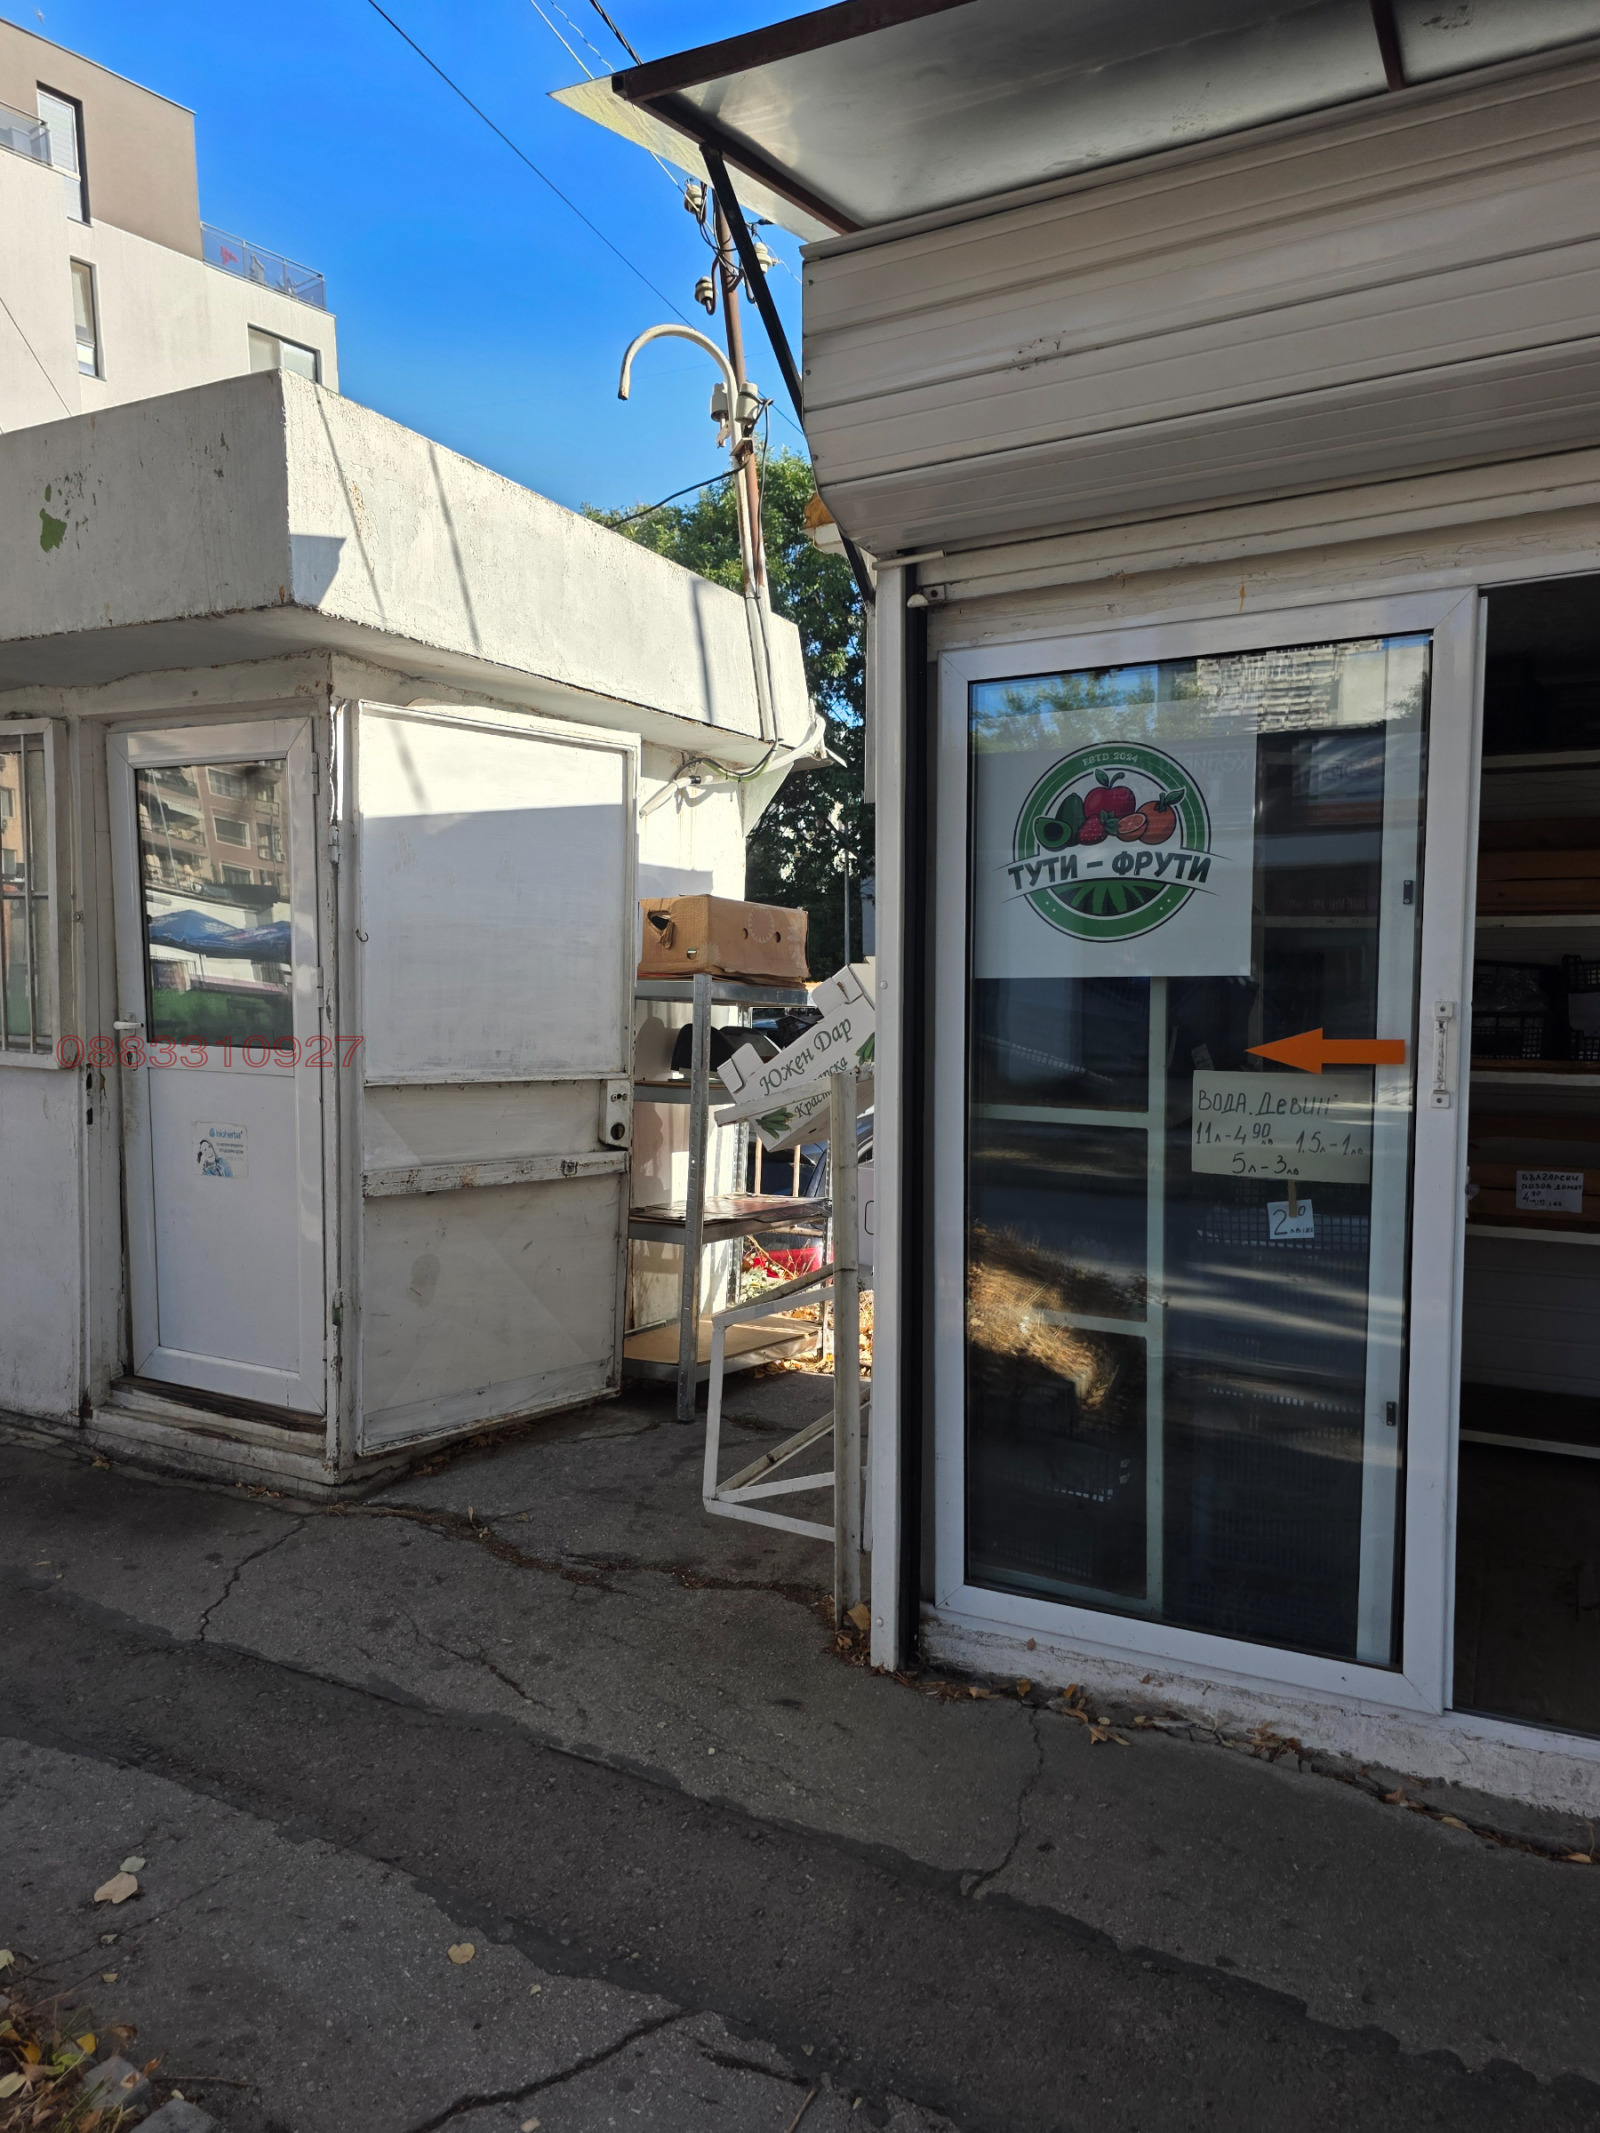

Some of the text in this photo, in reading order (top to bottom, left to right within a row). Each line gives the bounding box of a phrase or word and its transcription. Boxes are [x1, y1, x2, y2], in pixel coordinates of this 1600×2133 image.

[1113, 751, 1139, 764] 2024
[1007, 854, 1078, 891] ТУТИ
[1111, 851, 1212, 884] ФРУТИ
[759, 1047, 814, 1096] Южен
[813, 1018, 853, 1053] Дар
